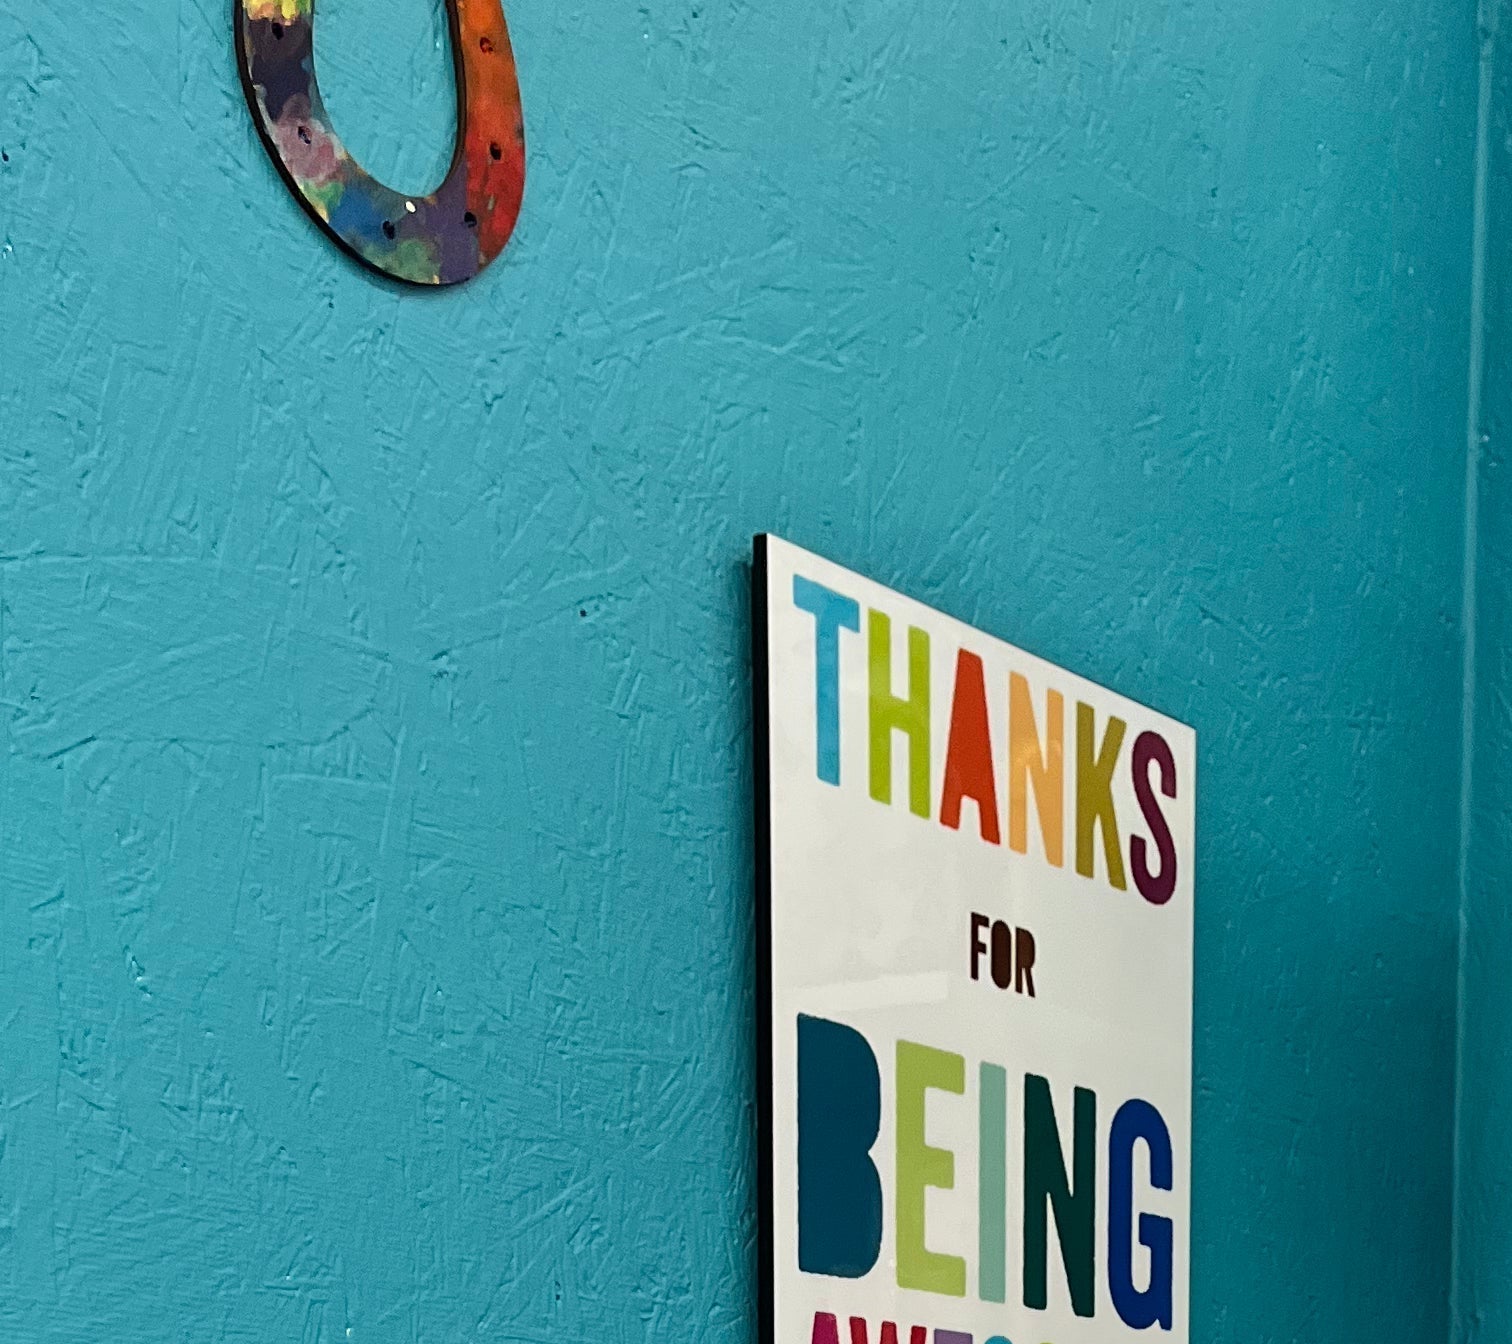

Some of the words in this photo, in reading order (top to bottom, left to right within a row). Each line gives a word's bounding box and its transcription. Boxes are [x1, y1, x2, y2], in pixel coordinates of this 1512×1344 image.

[791, 572, 1178, 906] THANKS
[969, 910, 1036, 999] FOR
[795, 1012, 1174, 1331] BEING
